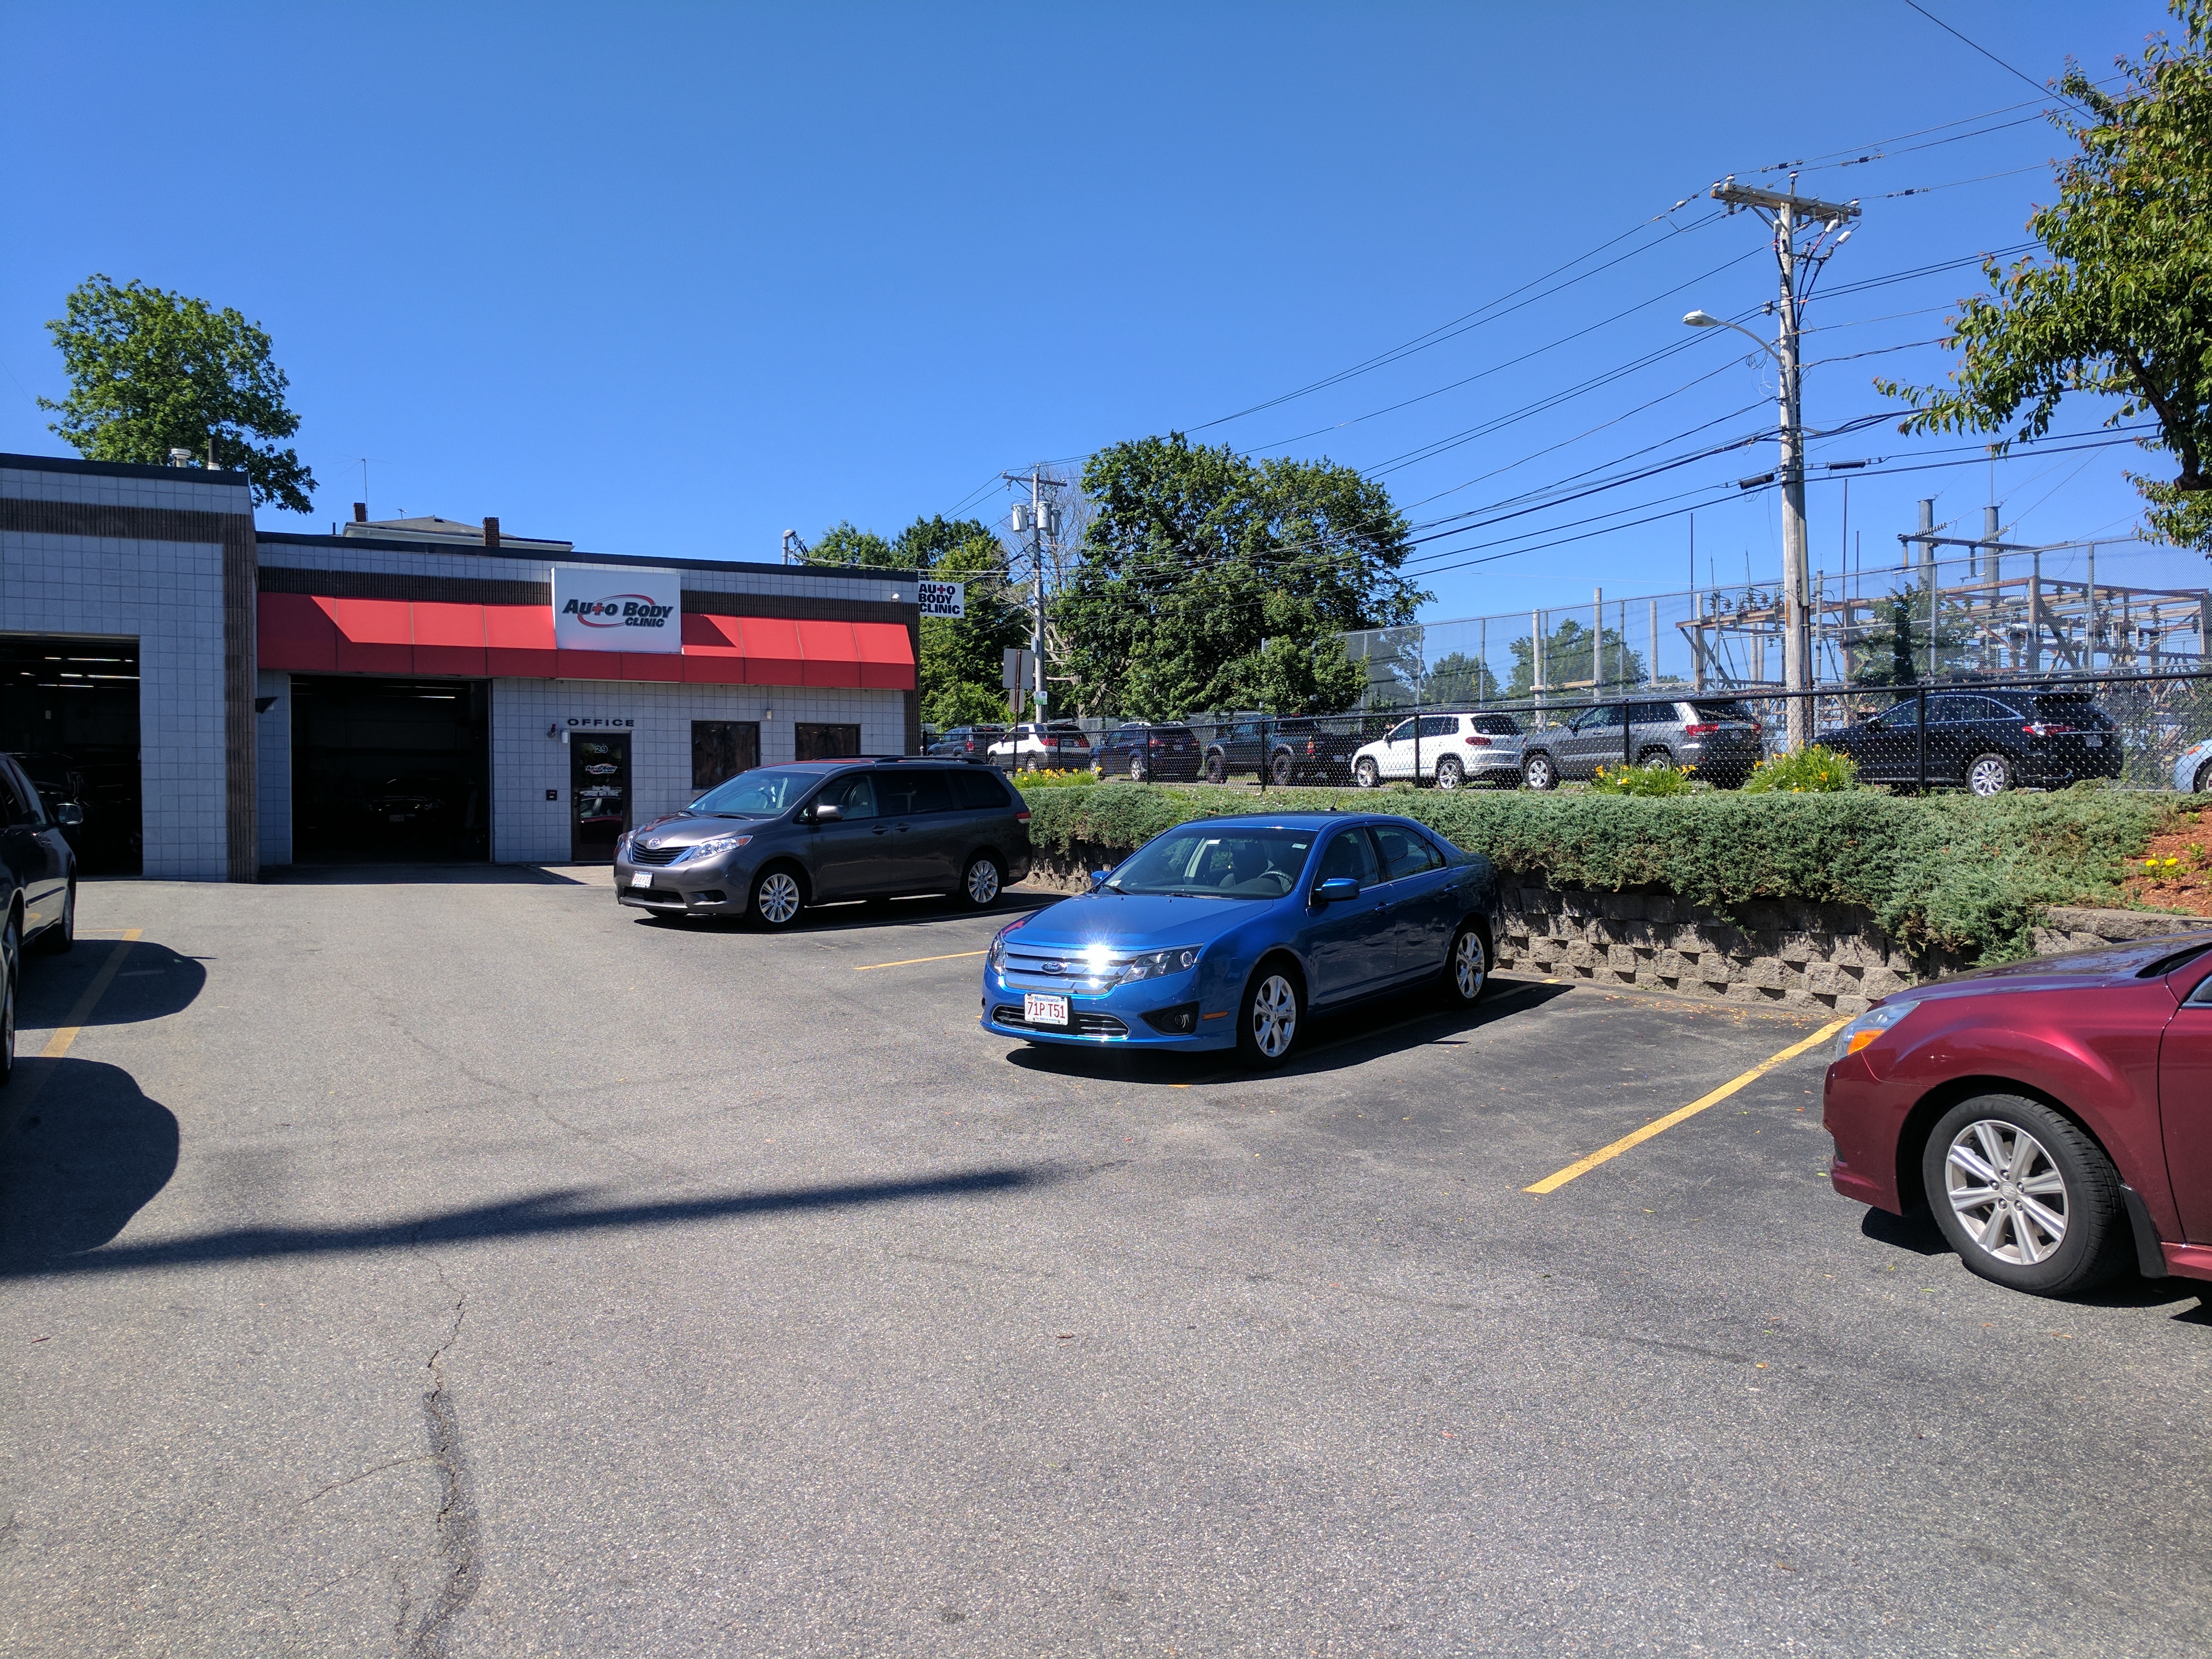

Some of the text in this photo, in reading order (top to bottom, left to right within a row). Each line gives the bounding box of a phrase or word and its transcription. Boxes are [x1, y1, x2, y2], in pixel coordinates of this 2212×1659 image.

[919, 593, 952, 604] BODY
[622, 602, 674, 619] BODY
[920, 603, 960, 614] CLINIC
[625, 617, 665, 627] CLINIC
[595, 745, 608, 754] 29
[1028, 1002, 1065, 1019] 71P T51
